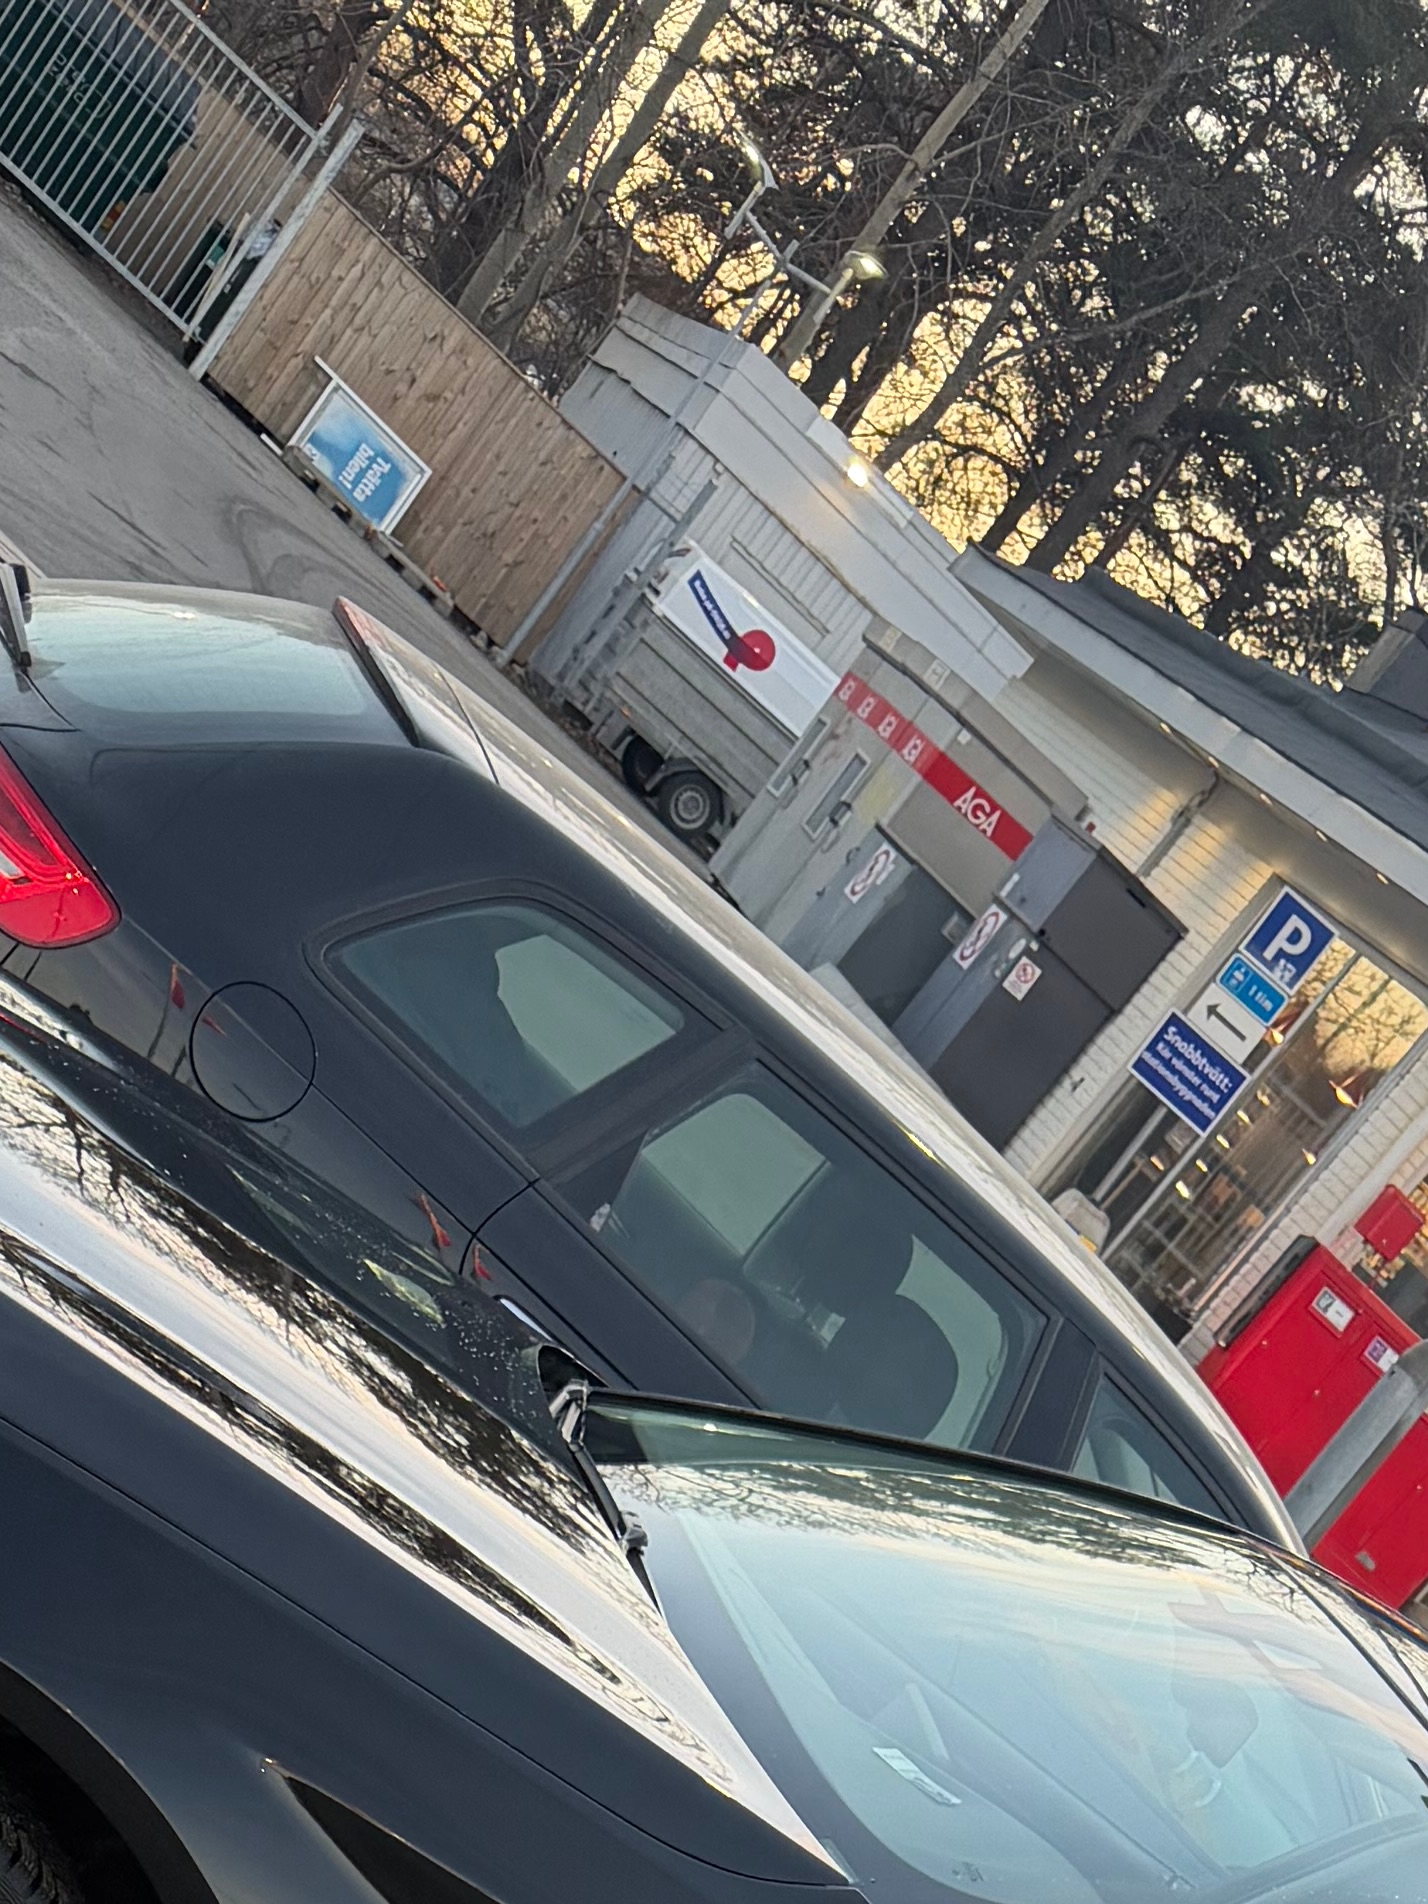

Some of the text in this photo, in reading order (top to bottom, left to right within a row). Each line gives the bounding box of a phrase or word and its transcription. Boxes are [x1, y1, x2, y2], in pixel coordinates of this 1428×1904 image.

[337, 442, 374, 489] bilen!
[351, 456, 392, 503] Tvätta
[951, 784, 1002, 837] AGA
[1262, 914, 1312, 961] P
[1247, 983, 1275, 1013] 1 tim
[1162, 1025, 1234, 1093] Snabbtvätt:
